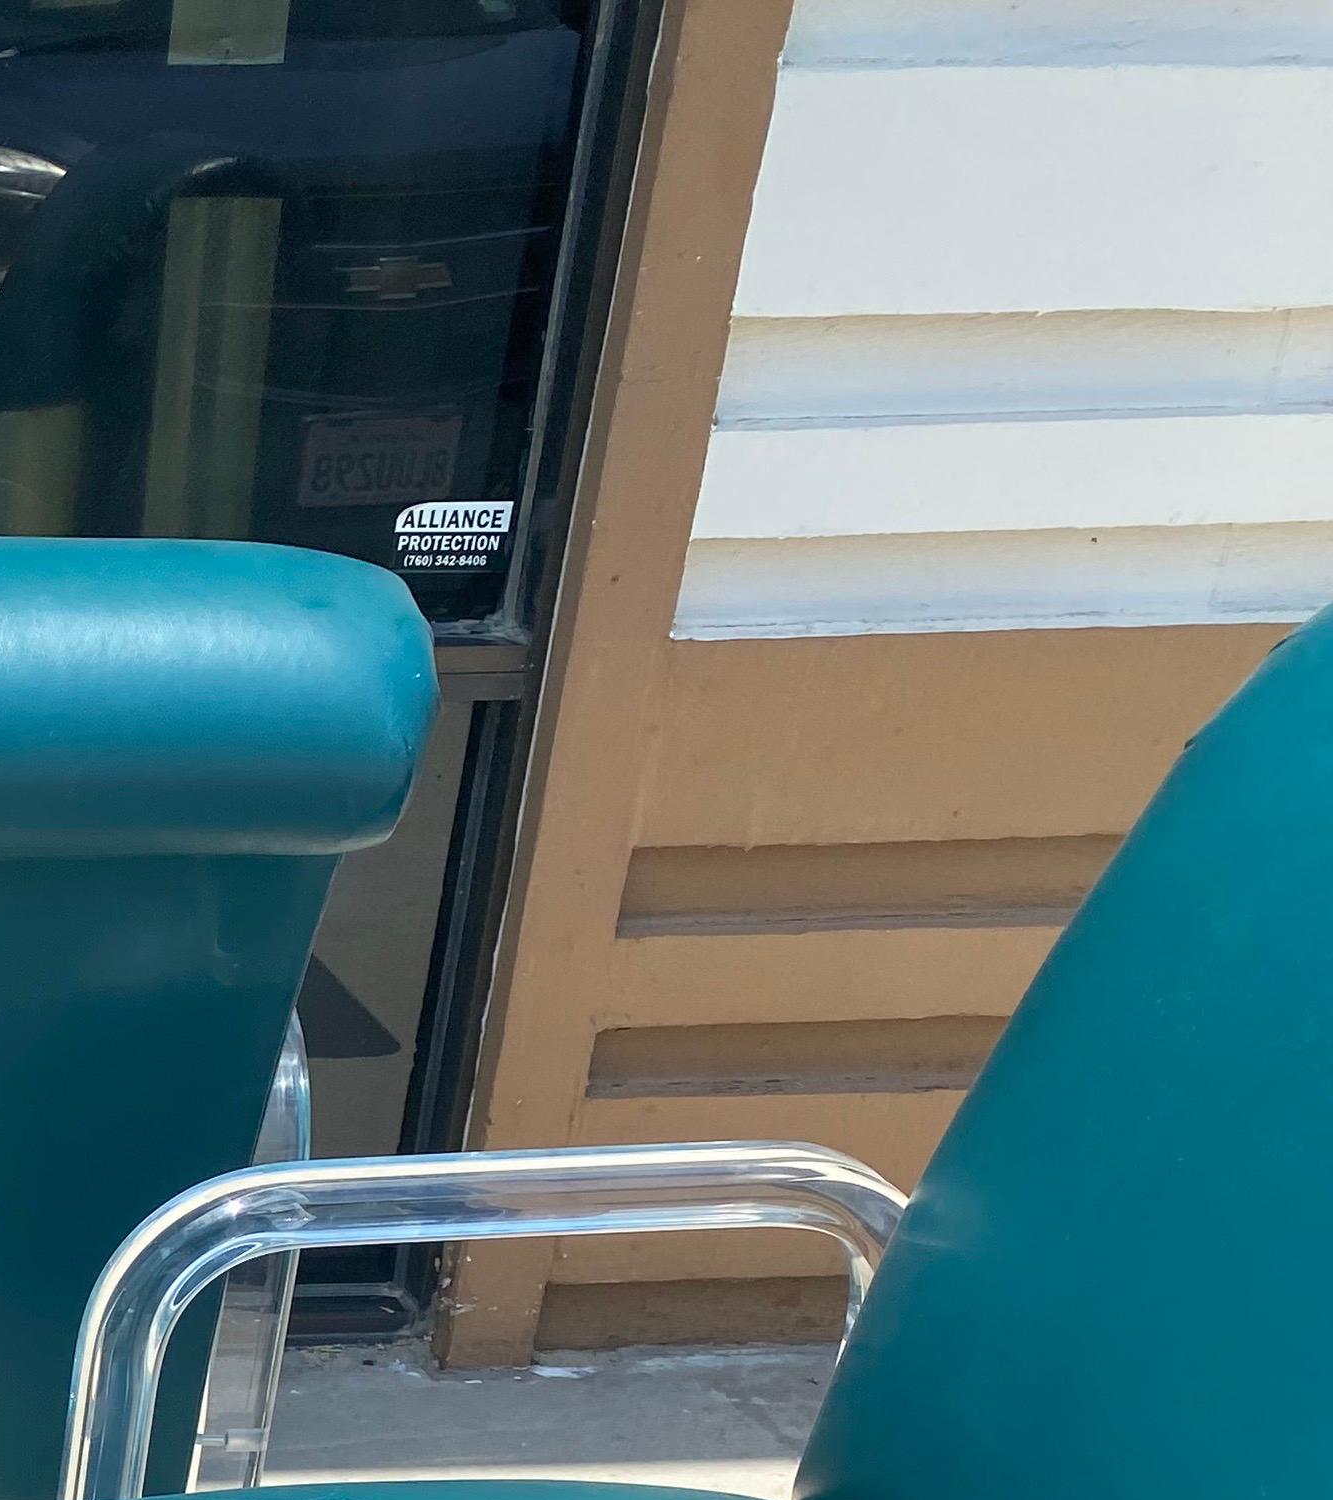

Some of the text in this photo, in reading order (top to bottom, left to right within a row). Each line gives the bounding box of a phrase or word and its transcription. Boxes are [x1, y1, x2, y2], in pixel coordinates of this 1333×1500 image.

[402, 510, 504, 528] ALLIANCE
[397, 535, 500, 551] PROTECTION
[404, 555, 487, 567] (760) 342-8406
